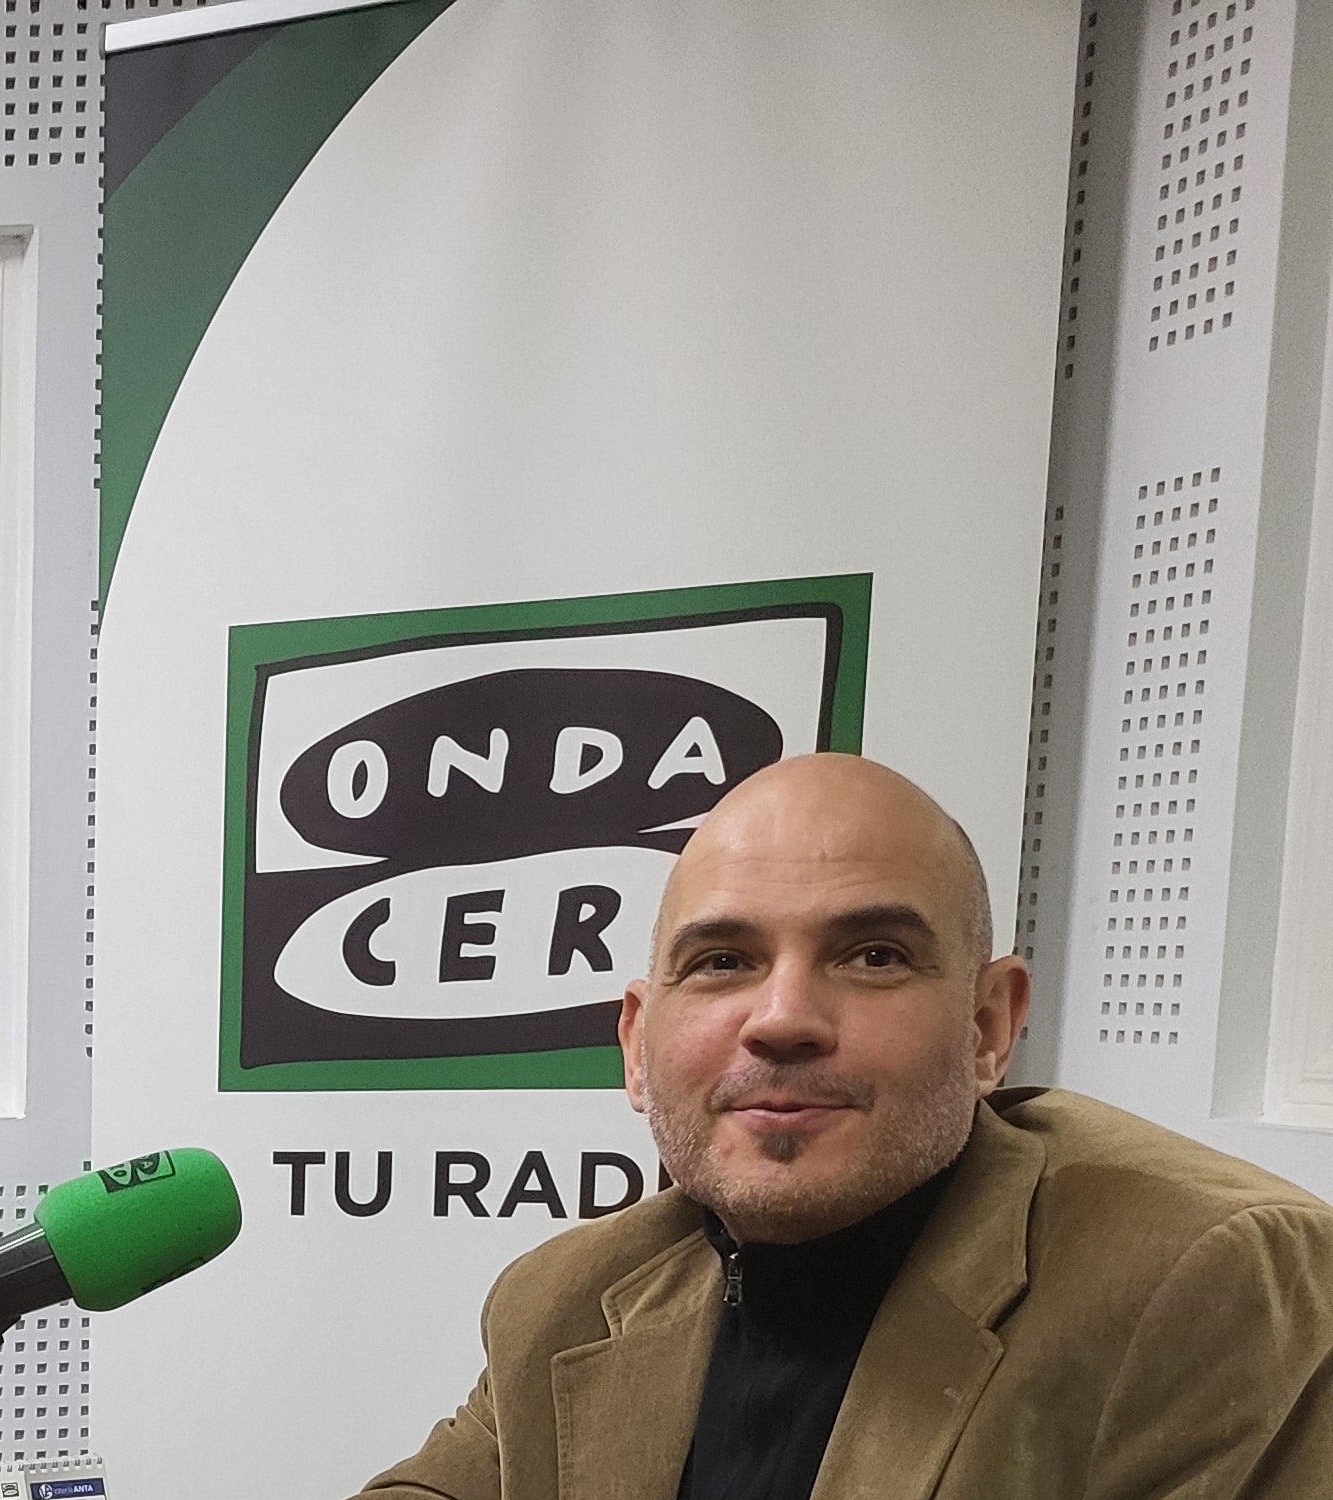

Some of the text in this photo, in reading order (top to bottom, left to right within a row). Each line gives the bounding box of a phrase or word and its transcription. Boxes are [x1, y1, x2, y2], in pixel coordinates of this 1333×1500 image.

[327, 716, 727, 819] ONDA
[342, 884, 622, 987] CER
[273, 1150, 673, 1219] TU RAD
